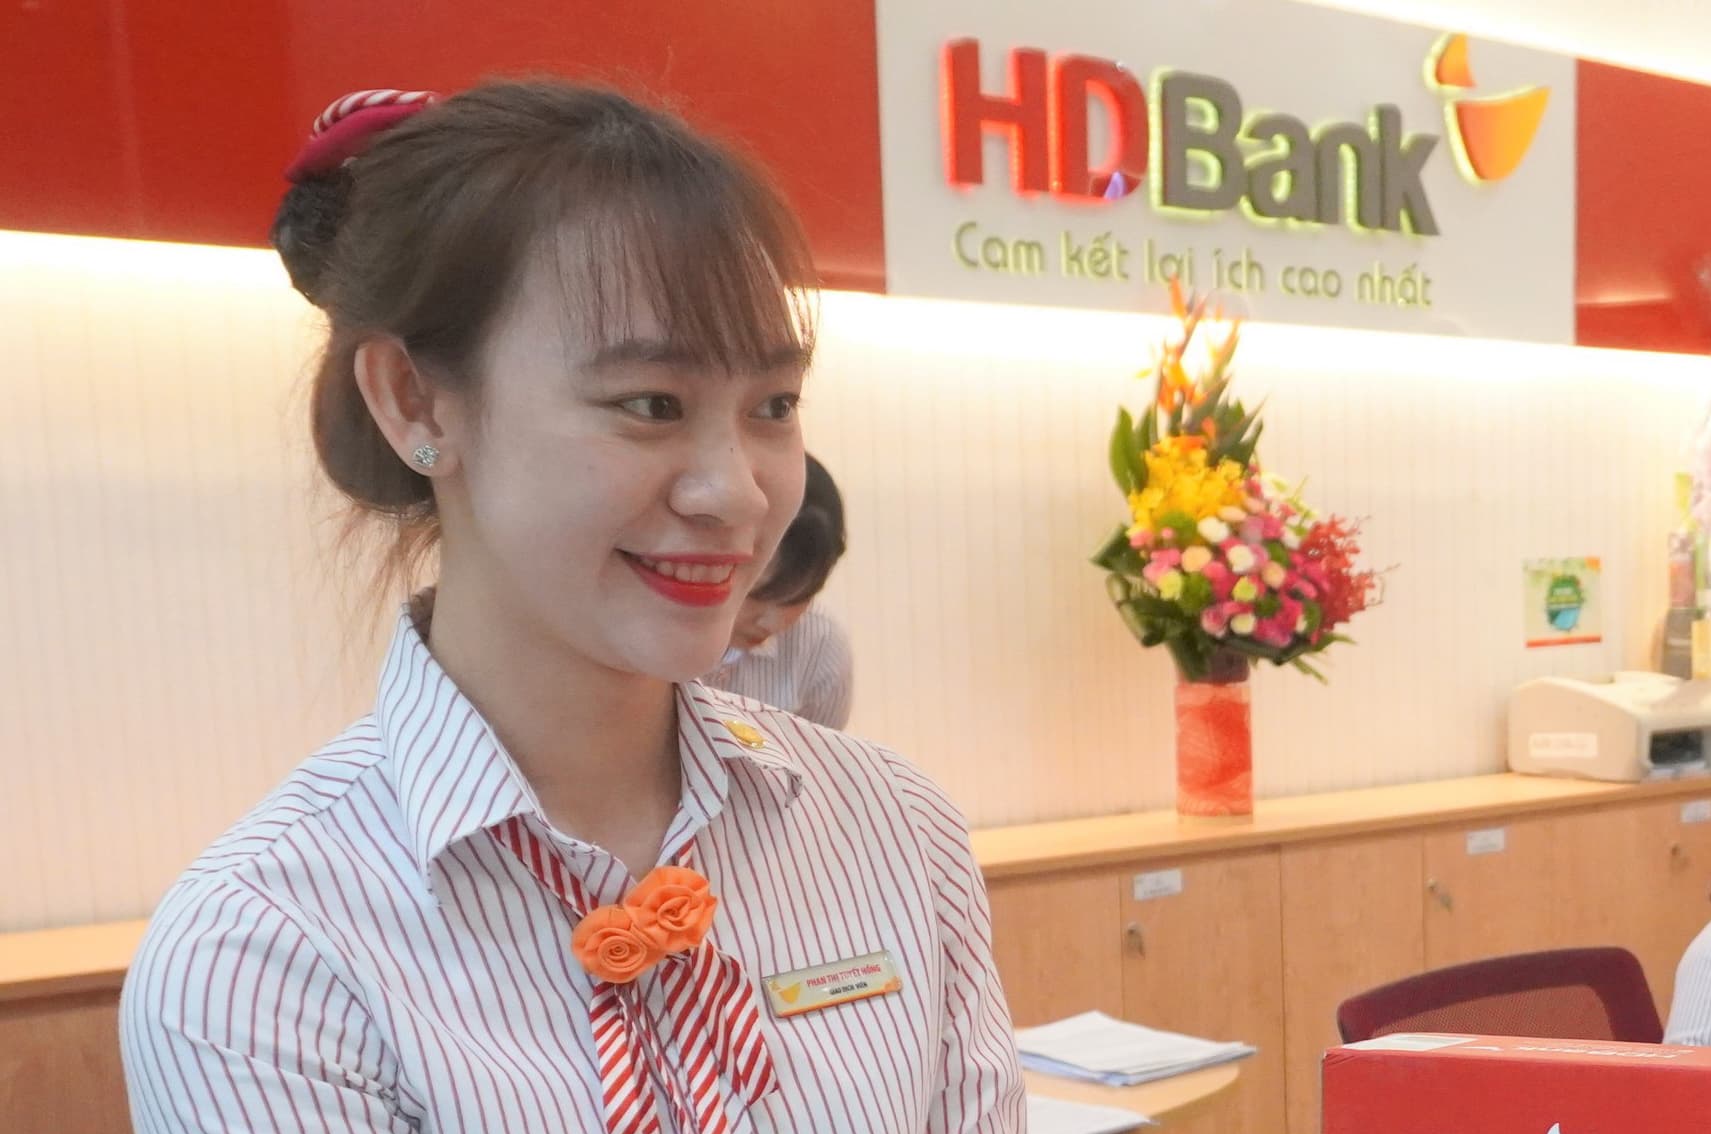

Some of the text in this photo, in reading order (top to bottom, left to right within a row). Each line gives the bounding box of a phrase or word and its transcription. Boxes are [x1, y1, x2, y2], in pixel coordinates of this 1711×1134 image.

[941, 37, 1440, 237] HDBank
[954, 221, 1044, 274] Cam
[1060, 230, 1130, 281] kết
[1213, 247, 1264, 291] ích
[1280, 265, 1341, 299] cao
[1357, 260, 1433, 306] nhất
